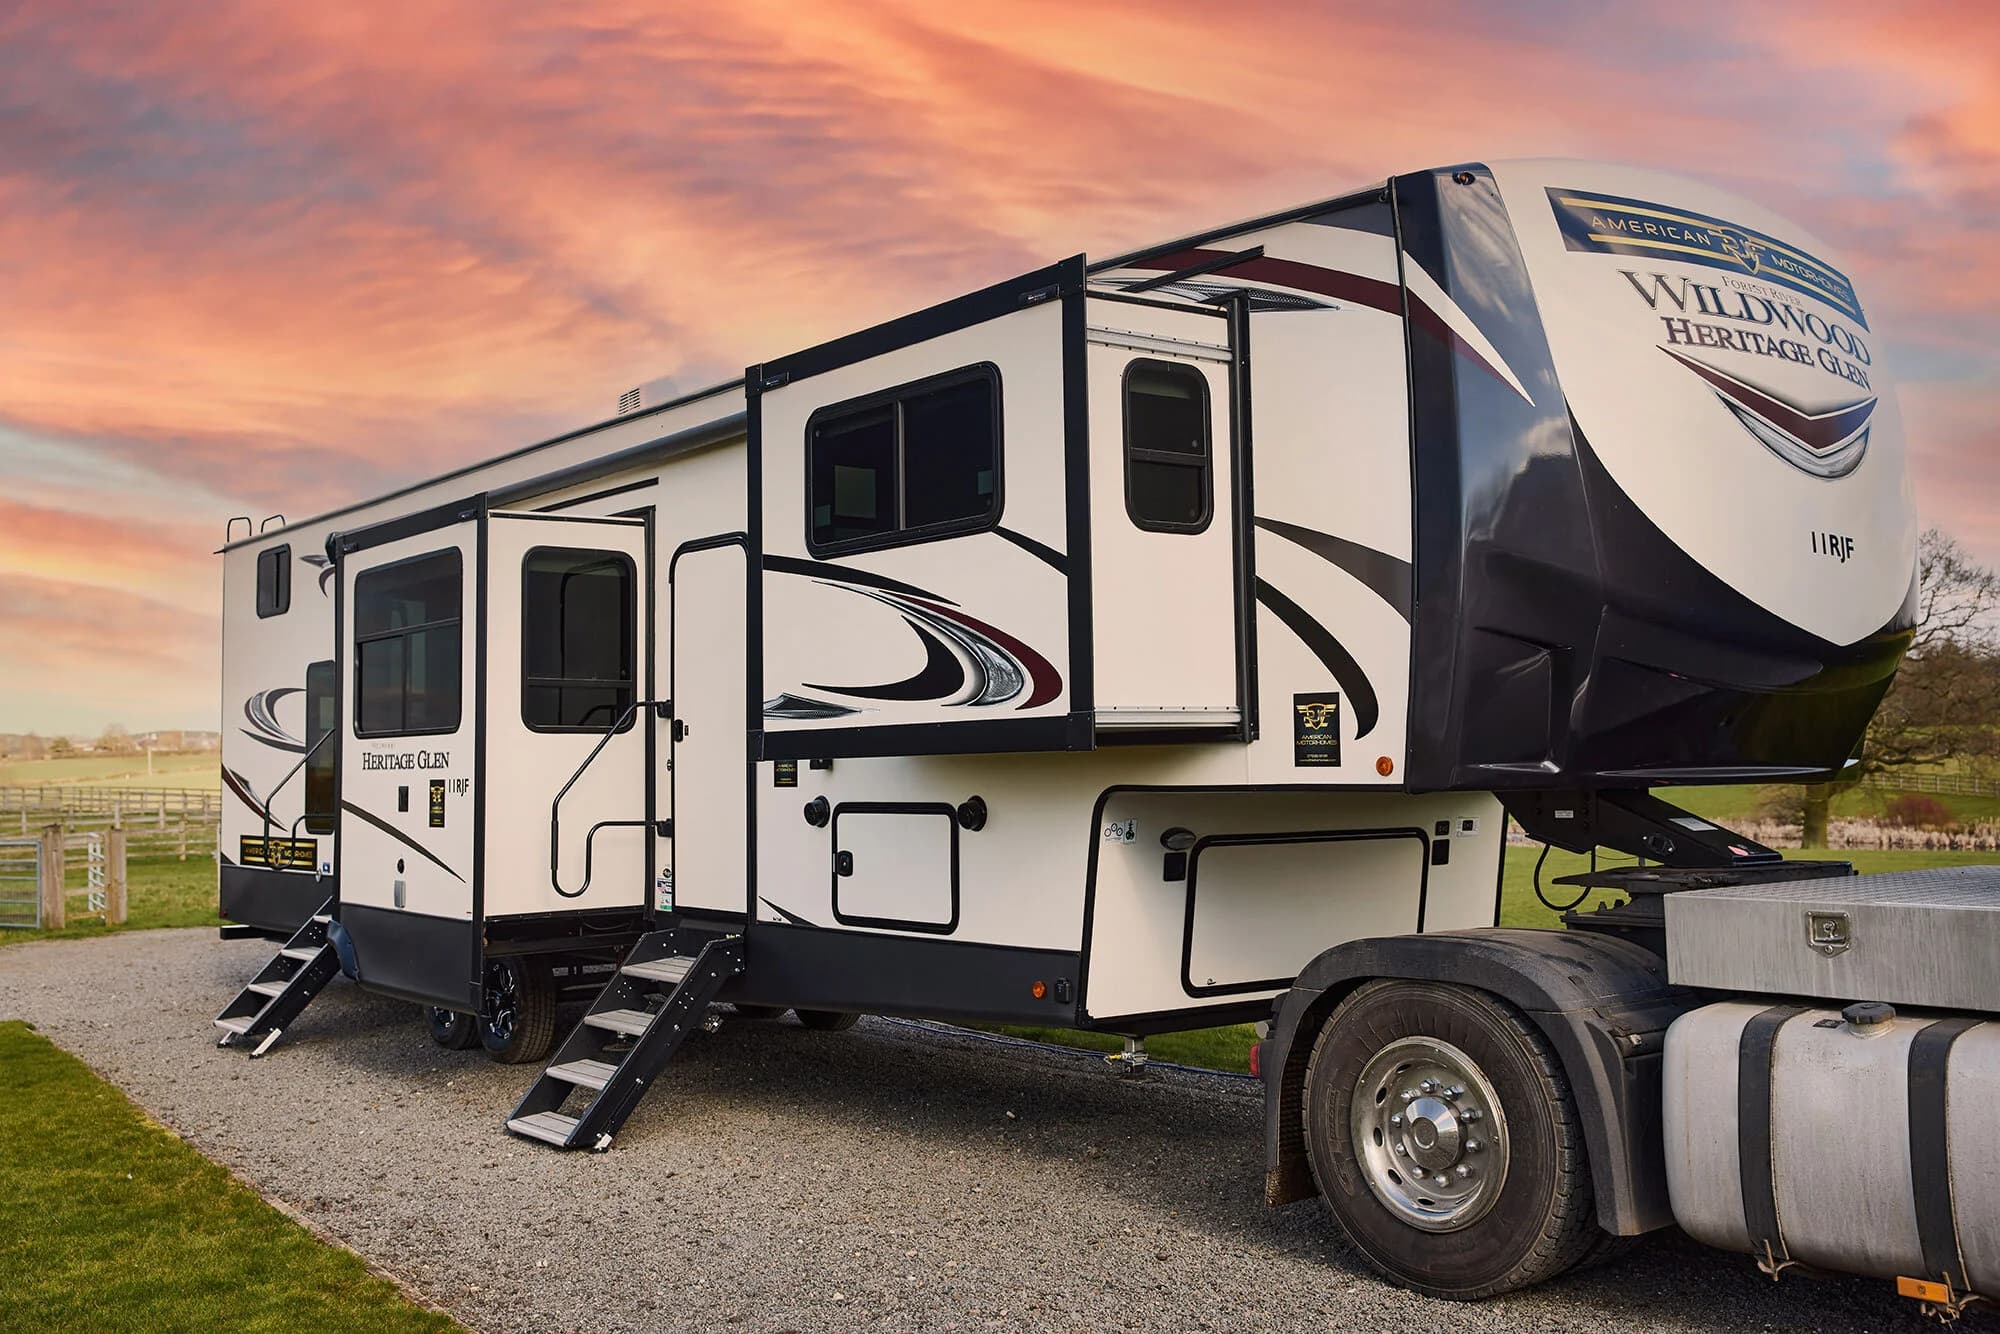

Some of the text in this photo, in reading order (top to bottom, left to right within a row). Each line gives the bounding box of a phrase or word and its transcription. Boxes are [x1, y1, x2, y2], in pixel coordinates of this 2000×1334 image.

[1591, 215, 1711, 246] AMERICAN
[1616, 269, 1872, 366] WILDWOOD
[1660, 316, 1872, 392] HERITAGE GLEN
[362, 749, 450, 770] HERITAGE GLEN
